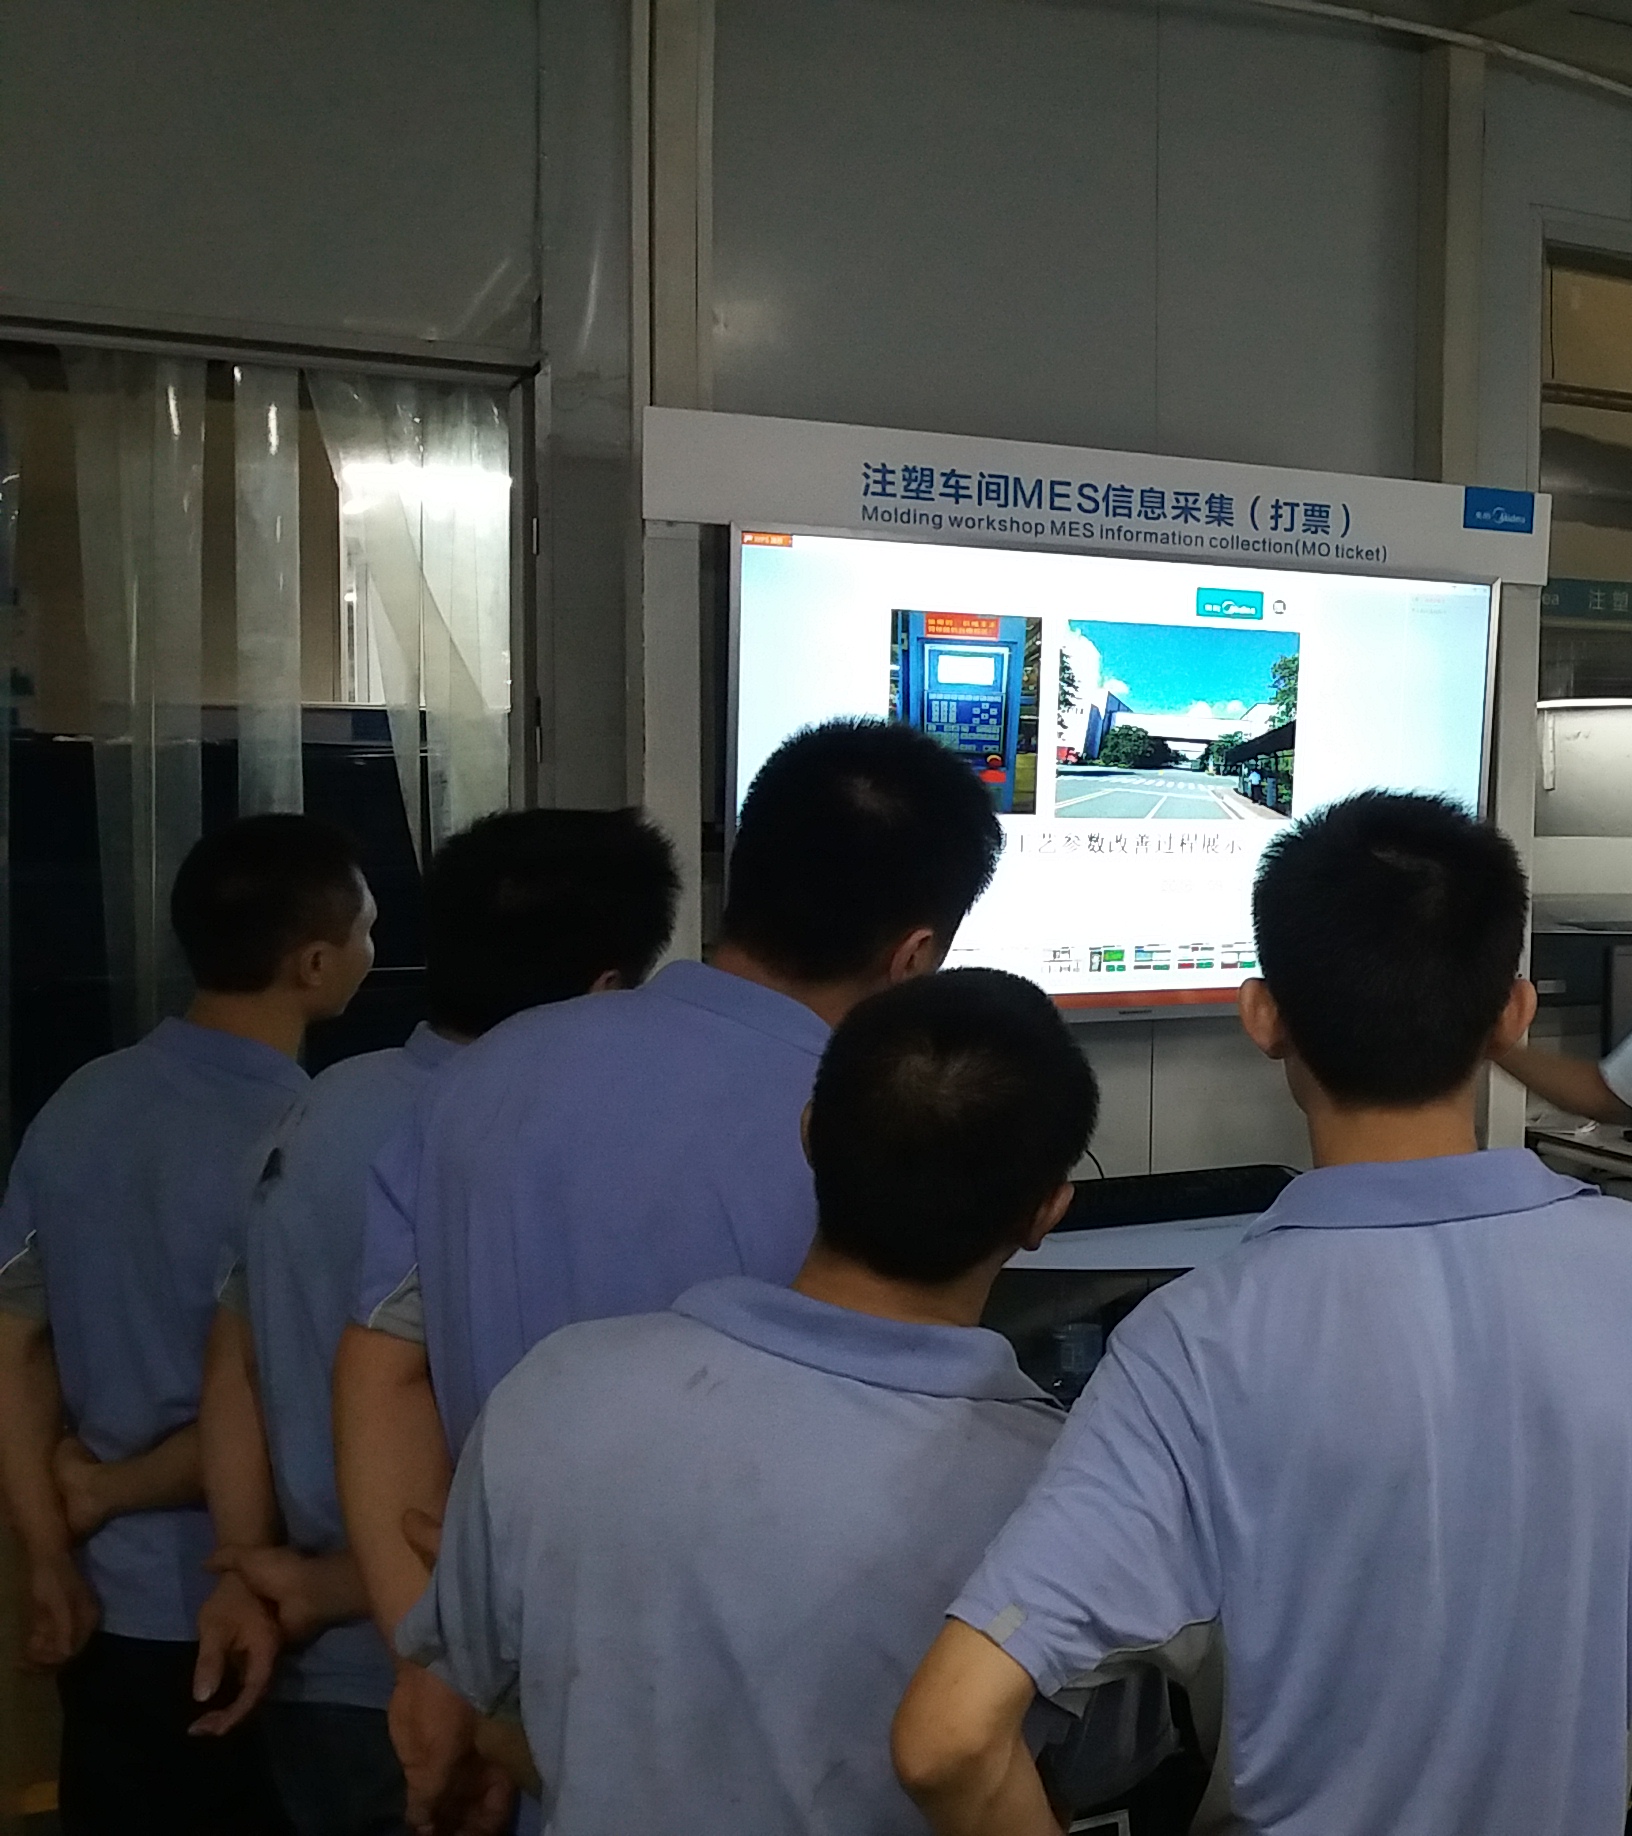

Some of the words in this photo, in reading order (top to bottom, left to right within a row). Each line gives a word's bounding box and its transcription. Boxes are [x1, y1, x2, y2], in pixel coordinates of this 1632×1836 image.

[861, 504, 943, 530] Molding
[948, 514, 1046, 538] workshop
[1050, 520, 1095, 539] MES
[1335, 543, 1388, 563] ticket)
[1003, 832, 1243, 854] 工艺参数改善过程展示
